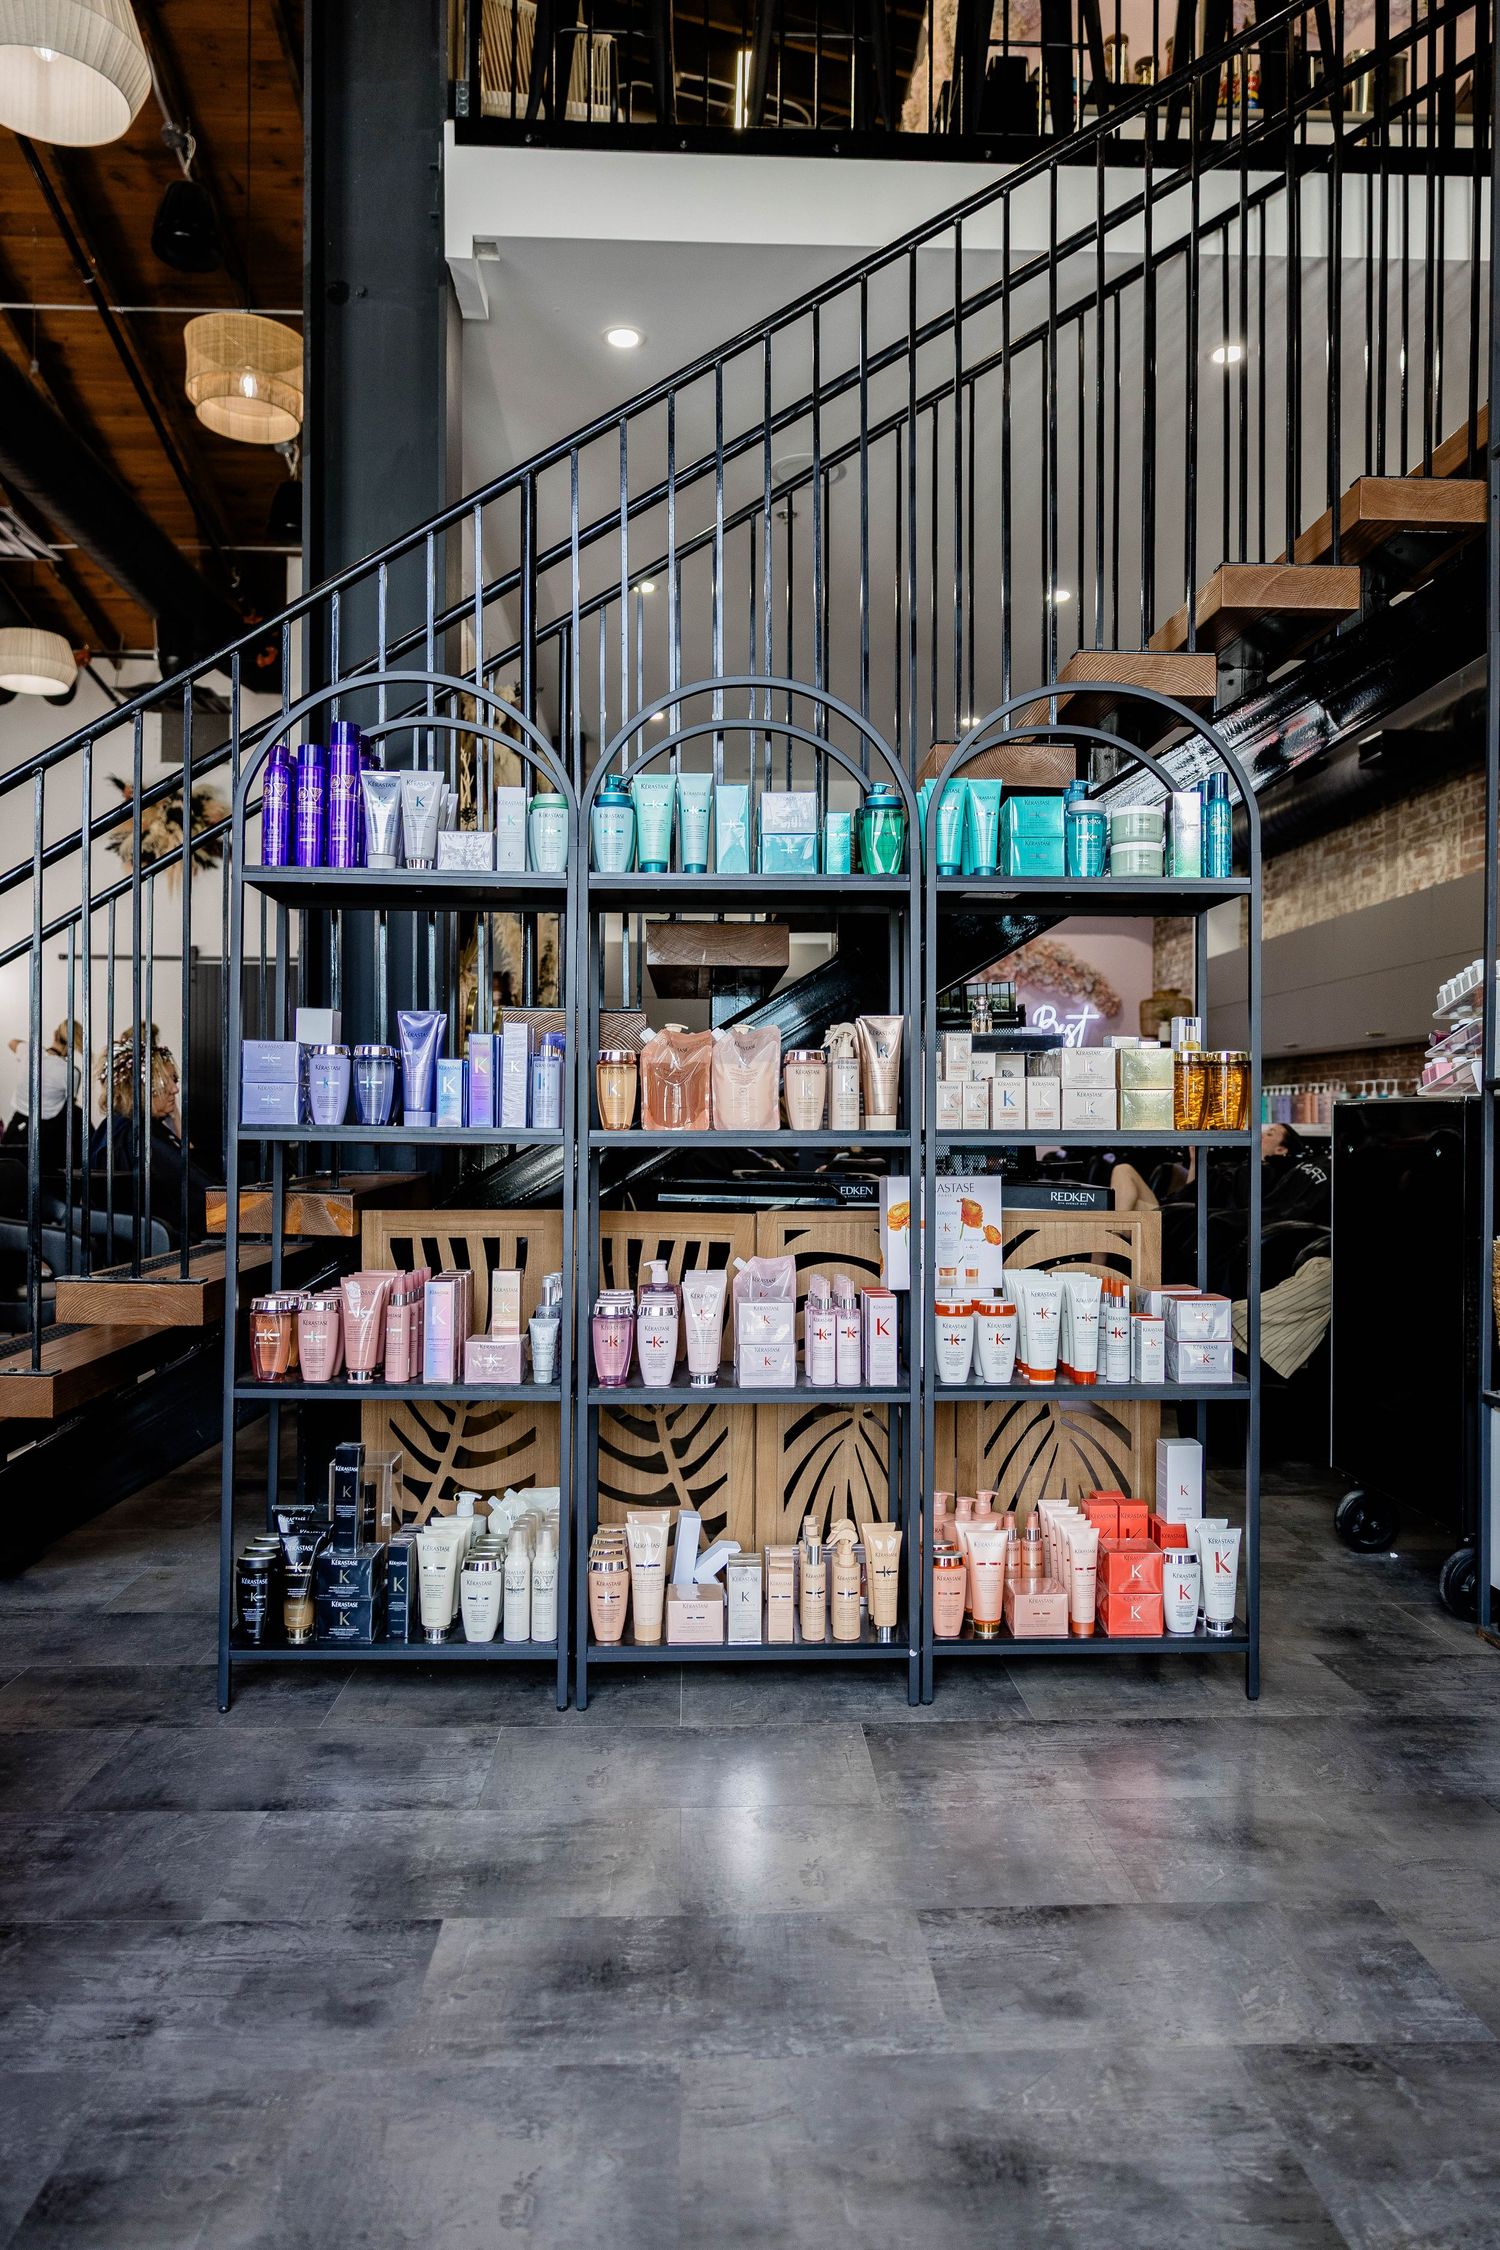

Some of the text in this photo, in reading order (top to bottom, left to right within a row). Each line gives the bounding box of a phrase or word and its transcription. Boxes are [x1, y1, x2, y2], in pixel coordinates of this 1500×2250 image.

[1032, 1005, 1100, 1047] Best
[475, 1057, 487, 1074] K
[511, 1060, 519, 1072] K
[443, 1076, 455, 1093] K
[1003, 1090, 1015, 1107] K
[840, 1186, 873, 1195] EDKEN
[937, 1183, 975, 1193] ASTASE
[1050, 1191, 1095, 1203] REDKEN
[431, 1306, 448, 1325] K
[1041, 1307, 1049, 1320] K
[876, 1318, 890, 1336] K
[1114, 1327, 1123, 1339] K
[652, 1336, 662, 1348] K
[951, 1334, 960, 1346] K
[996, 1333, 1004, 1345] K
[1215, 1551, 1232, 1574] K
[339, 1569, 350, 1584] K
[1131, 1564, 1142, 1578] K
[393, 1577, 405, 1592] K
[1179, 1584, 1191, 1600] K
[339, 1612, 350, 1625] K
[1131, 1606, 1141, 1619] K
